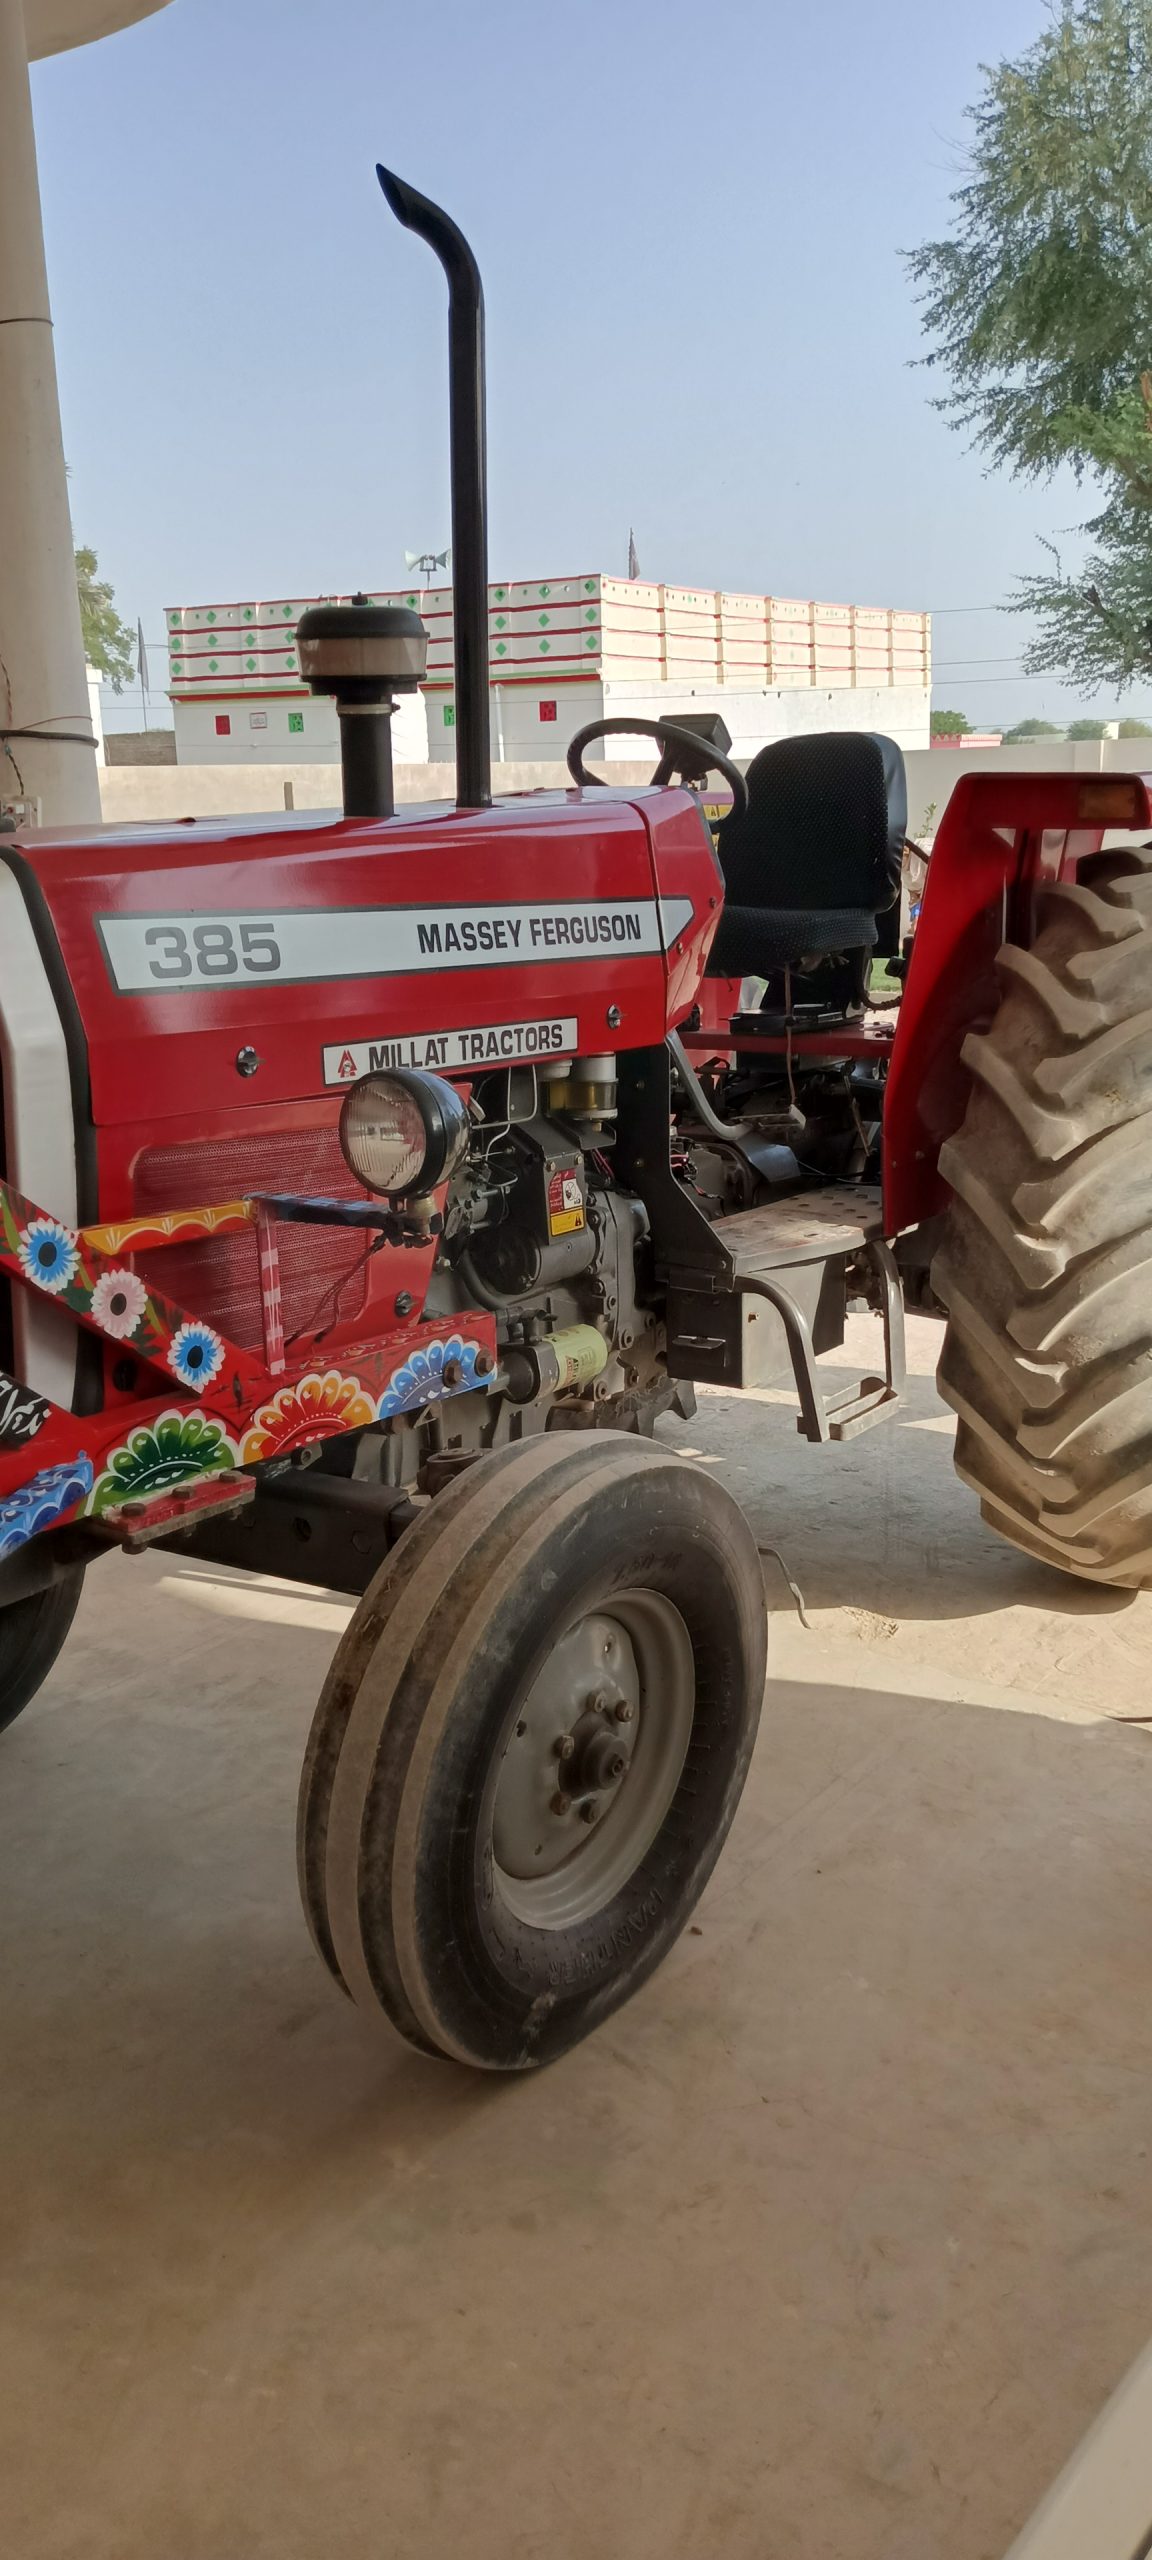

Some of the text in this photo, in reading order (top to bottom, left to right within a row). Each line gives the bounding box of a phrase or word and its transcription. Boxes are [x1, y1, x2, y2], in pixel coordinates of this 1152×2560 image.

[144, 923, 281, 979] 385
[417, 913, 642, 954] MASSEY FERGUSON
[369, 1024, 563, 1072] MILLAT TRACTORS
[548, 1888, 664, 1986] PANTHER
